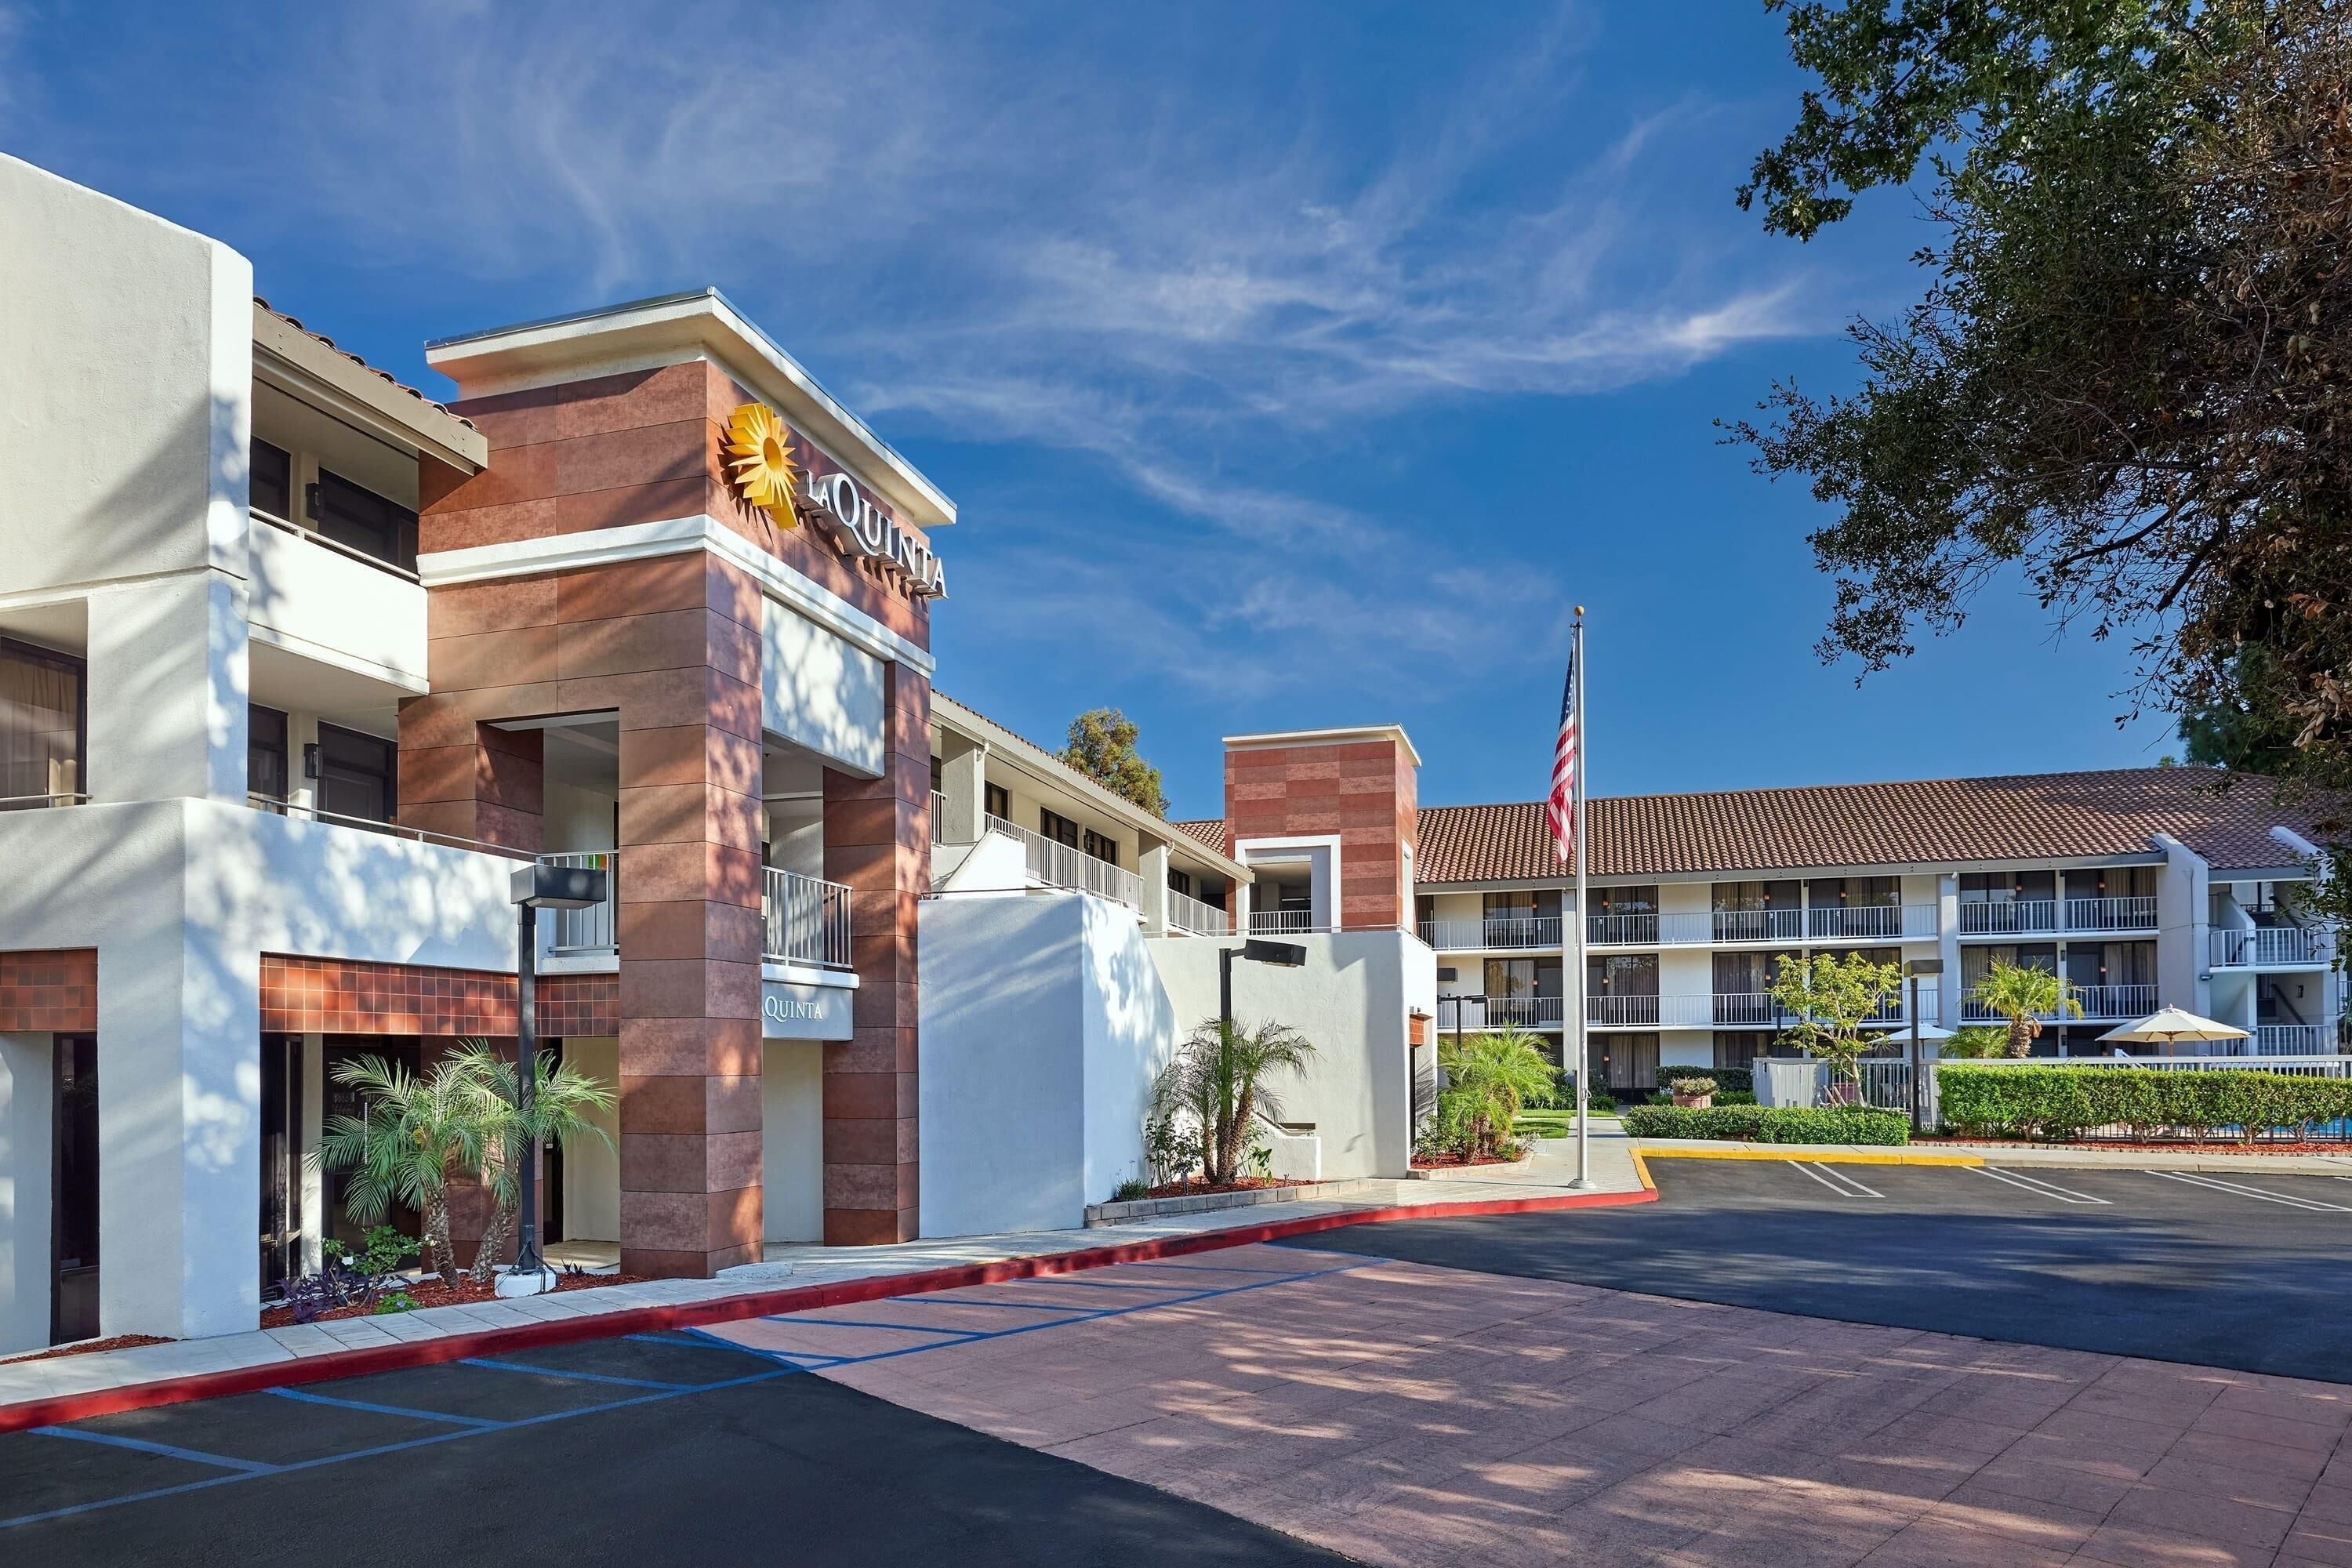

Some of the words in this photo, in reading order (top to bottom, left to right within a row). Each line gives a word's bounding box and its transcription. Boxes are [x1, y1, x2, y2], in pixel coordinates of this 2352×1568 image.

[804, 470, 833, 514] LA
[833, 473, 948, 599] QUINTA
[765, 996, 822, 1022] QUINTA
